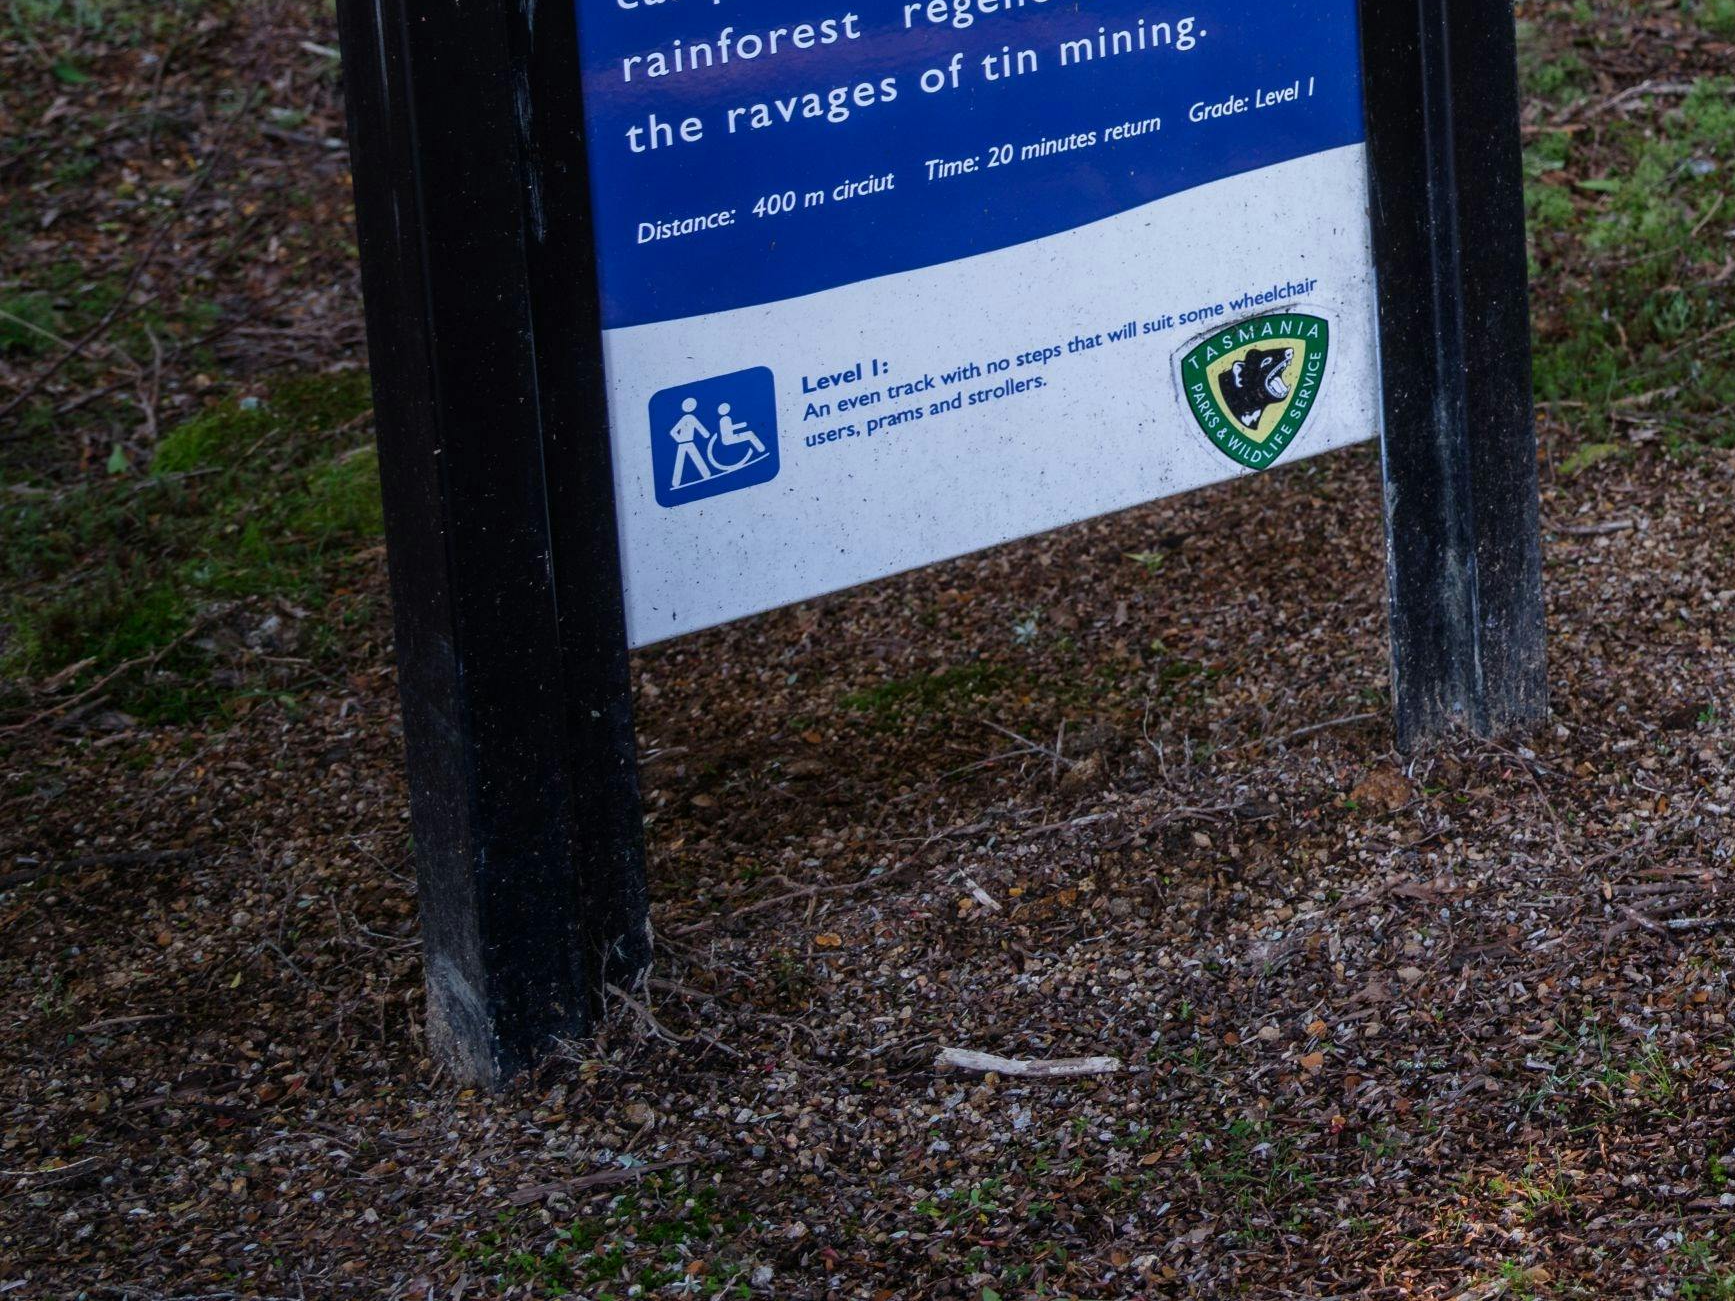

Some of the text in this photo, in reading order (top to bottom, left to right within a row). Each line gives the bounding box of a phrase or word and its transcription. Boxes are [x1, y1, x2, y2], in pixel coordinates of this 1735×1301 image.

[623, 12, 861, 83] rainforest
[625, 16, 1207, 153] the ravages of tin mining.
[637, 209, 736, 245] Distance:
[751, 190, 797, 218] 400
[804, 190, 825, 208] m
[832, 172, 895, 201] circiut
[924, 156, 980, 181] Time:
[986, 143, 1014, 168] 20
[1021, 131, 1097, 161] minutes
[1104, 117, 1161, 143] return
[1188, 94, 1249, 123] Grade:
[1255, 80, 1300, 109] Level
[801, 363, 862, 394] Level
[803, 278, 1318, 422] An even track with no steps that will suit some wheelchair
[1188, 320, 1318, 370] TASMANIA
[805, 376, 1047, 448] users, prams and strollers.
[1191, 351, 1322, 462] PARKS & WILDLIFE SERVICE
